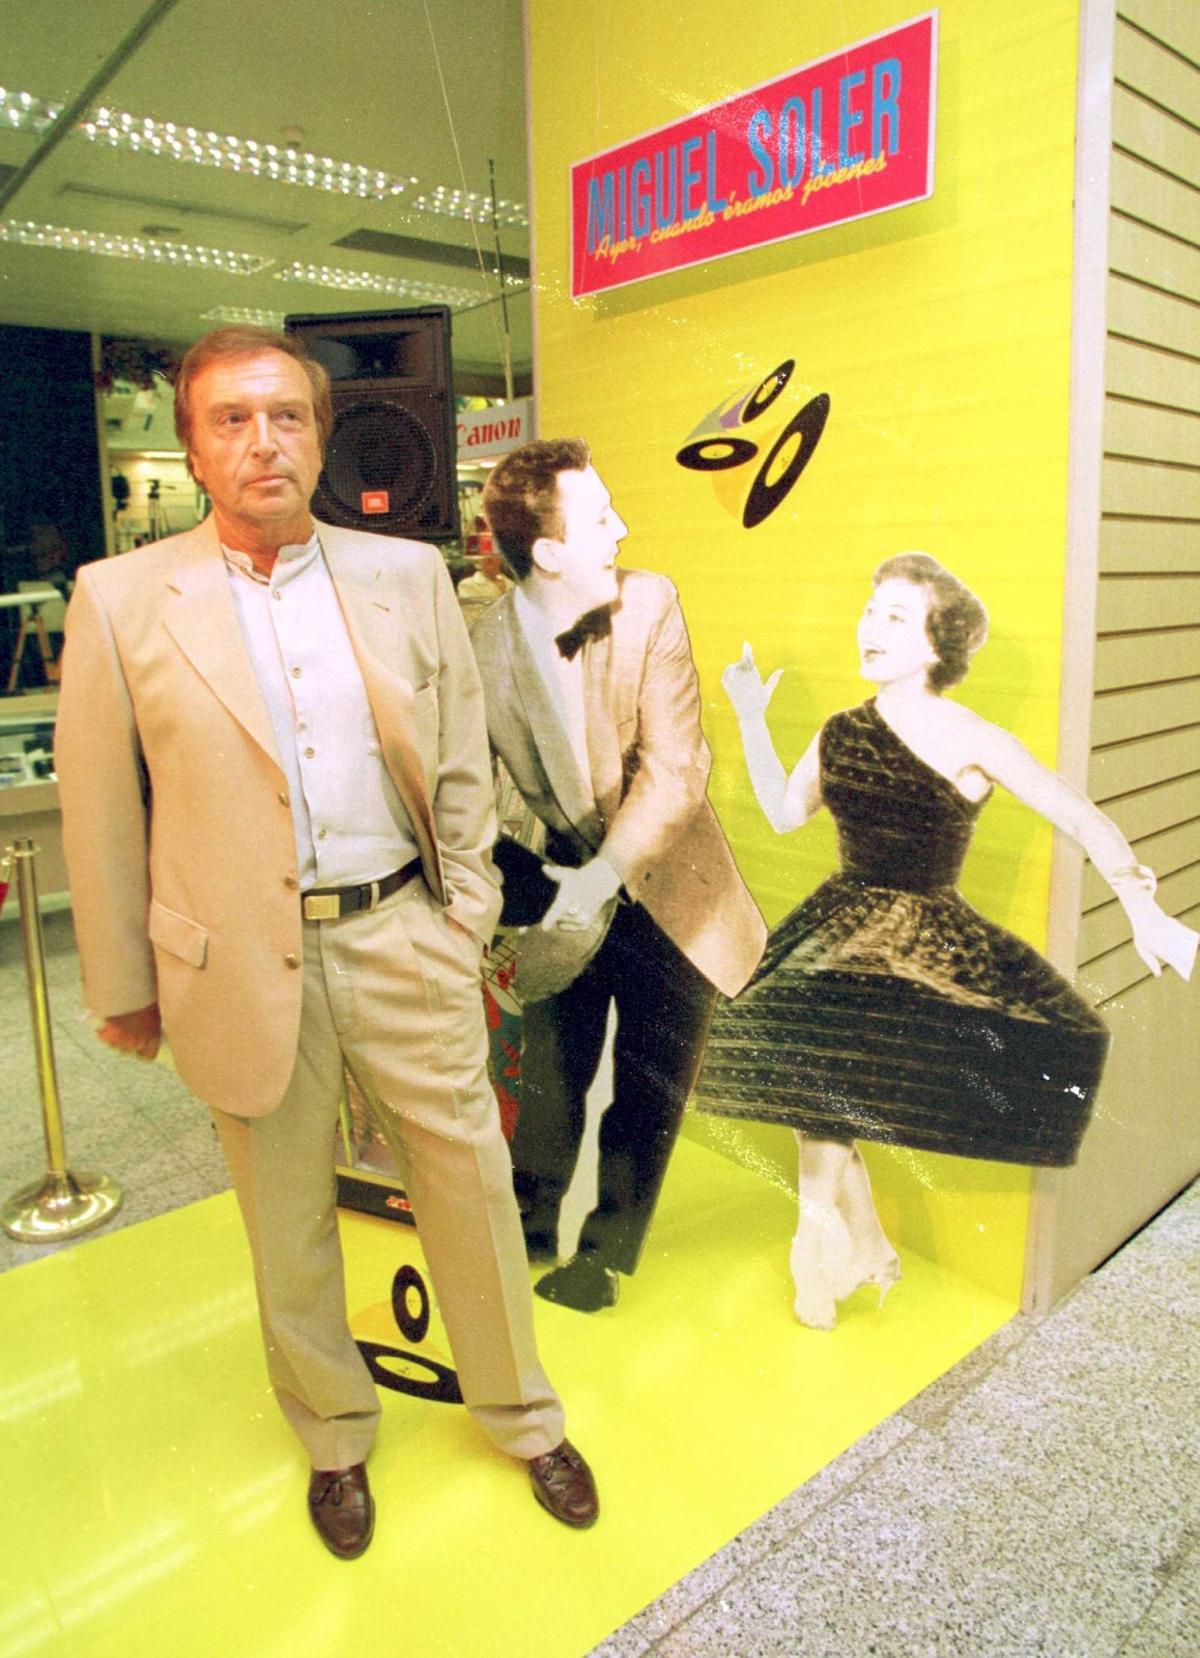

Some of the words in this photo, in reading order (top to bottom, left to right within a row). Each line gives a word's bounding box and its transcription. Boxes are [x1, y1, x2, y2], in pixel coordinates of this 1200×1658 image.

[587, 129, 728, 256] MIGUEL
[748, 57, 901, 198] SOLER
[594, 234, 642, 265] Ayer,
[650, 200, 715, 244] cuando
[723, 181, 793, 220] éramos
[801, 149, 887, 206] jóvenes
